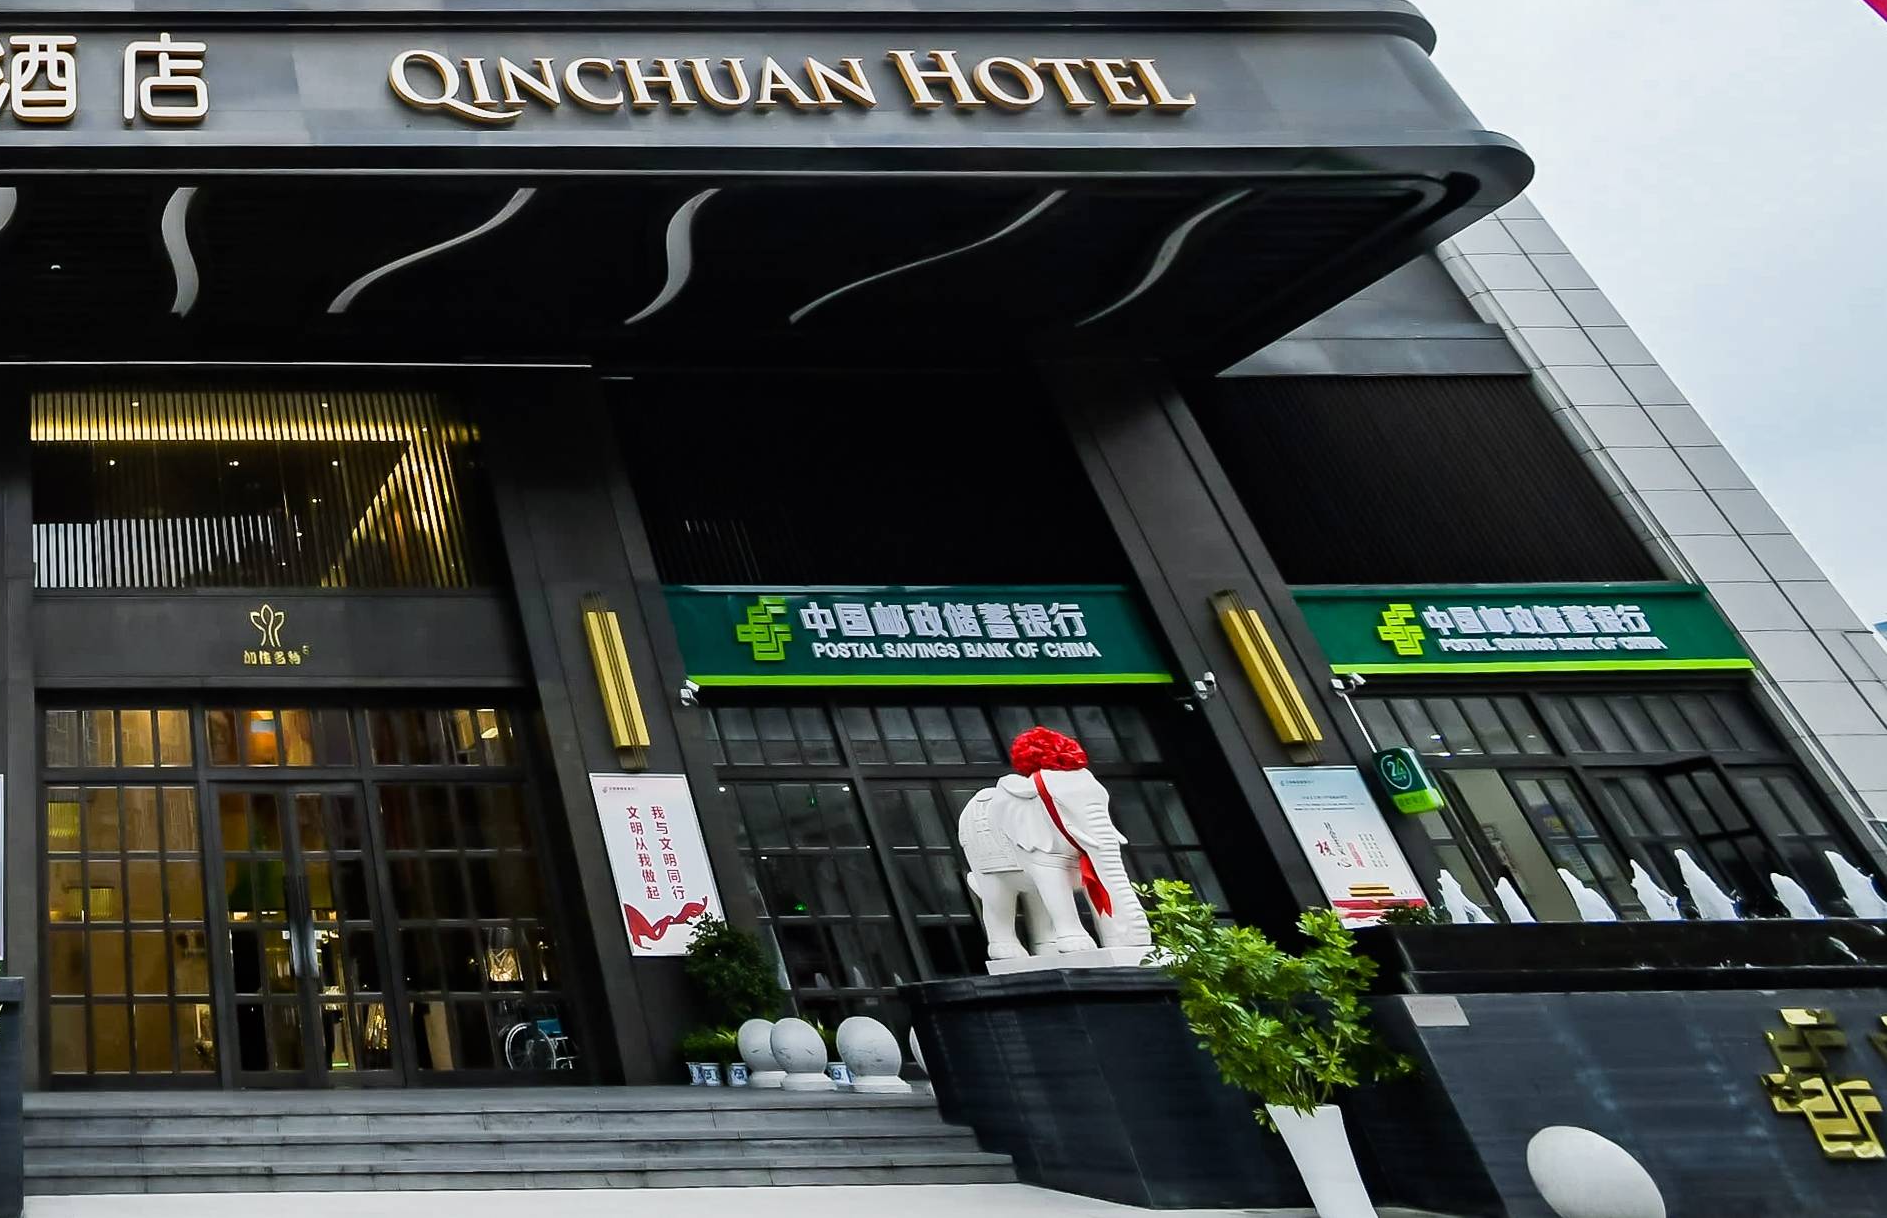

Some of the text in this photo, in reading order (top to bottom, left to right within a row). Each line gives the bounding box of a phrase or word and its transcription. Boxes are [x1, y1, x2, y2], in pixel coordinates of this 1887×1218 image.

[388, 48, 1197, 124] QINCHUAN HOTEL
[799, 601, 1087, 639] 中国邮政储蓄银行
[1422, 604, 1652, 636] 中国邮政储蓄银行
[812, 642, 1102, 659] POSTAL SAVINGS BANK OF CHINA
[626, 806, 661, 900] 文明从我做起
[651, 806, 686, 900] 我与文明同行
